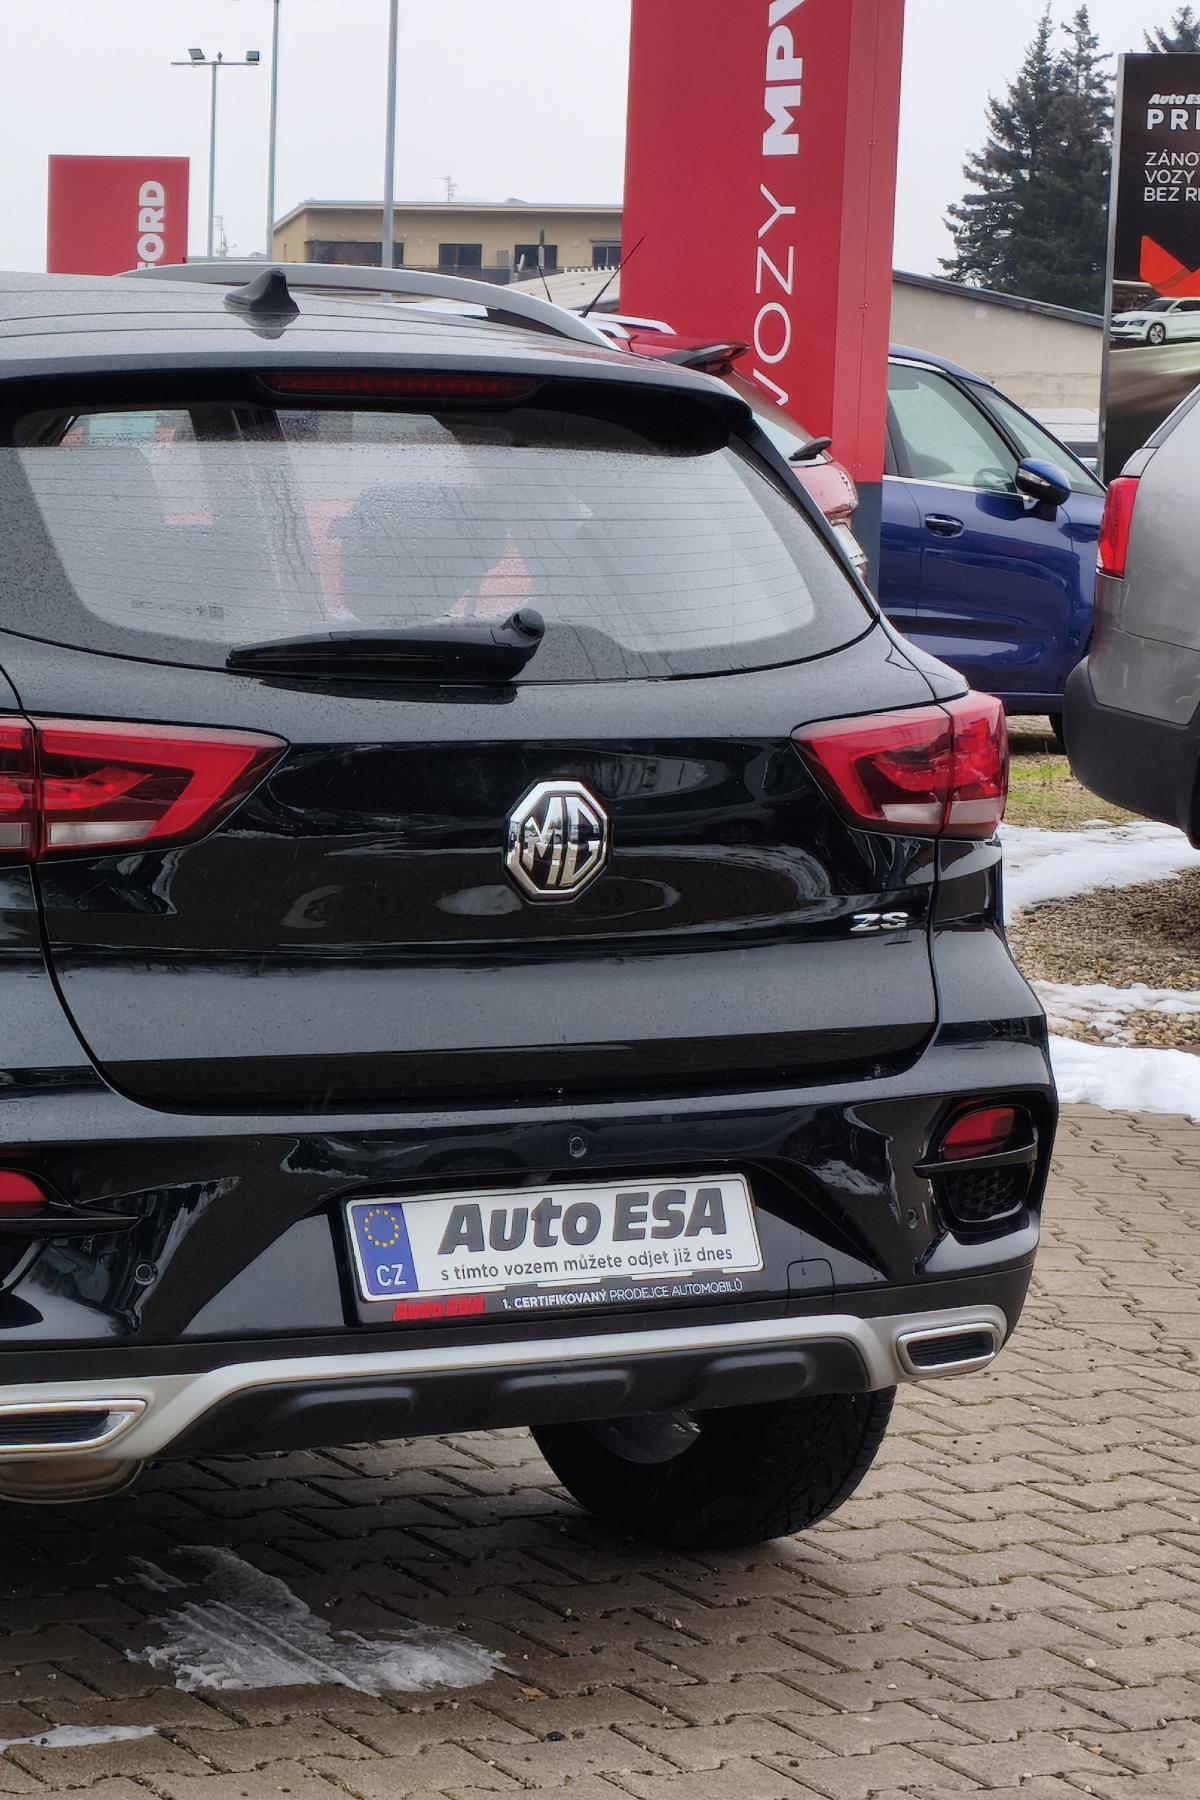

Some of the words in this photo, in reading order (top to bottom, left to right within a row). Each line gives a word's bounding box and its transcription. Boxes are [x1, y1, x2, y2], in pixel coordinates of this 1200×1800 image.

[1148, 93, 1185, 105] Auto
[1146, 108, 1200, 130] PR
[1144, 148, 1200, 167] ZÁNO
[1144, 169, 1196, 184] VOZY
[1143, 187, 1180, 202] BEZ
[1185, 187, 1200, 202] R
[753, 183, 796, 407] VOZY
[521, 792, 602, 890] MG
[850, 911, 909, 931] ZS
[438, 1198, 601, 1255] Auto
[612, 1188, 727, 1241] ESA
[376, 1263, 407, 1286] CZ
[441, 1269, 449, 1281] s
[504, 1260, 558, 1276] vozem
[563, 1253, 622, 1271] můžete
[627, 1250, 669, 1268] odjet
[672, 1247, 692, 1266] již
[696, 1246, 733, 1261] dnes
[502, 1298, 512, 1310] 1.
[514, 1289, 607, 1309] CERTIFIKOVANÝ
[609, 1286, 669, 1301] PRODEJCE
[671, 1277, 743, 1296] AUTOMOBILŮ
